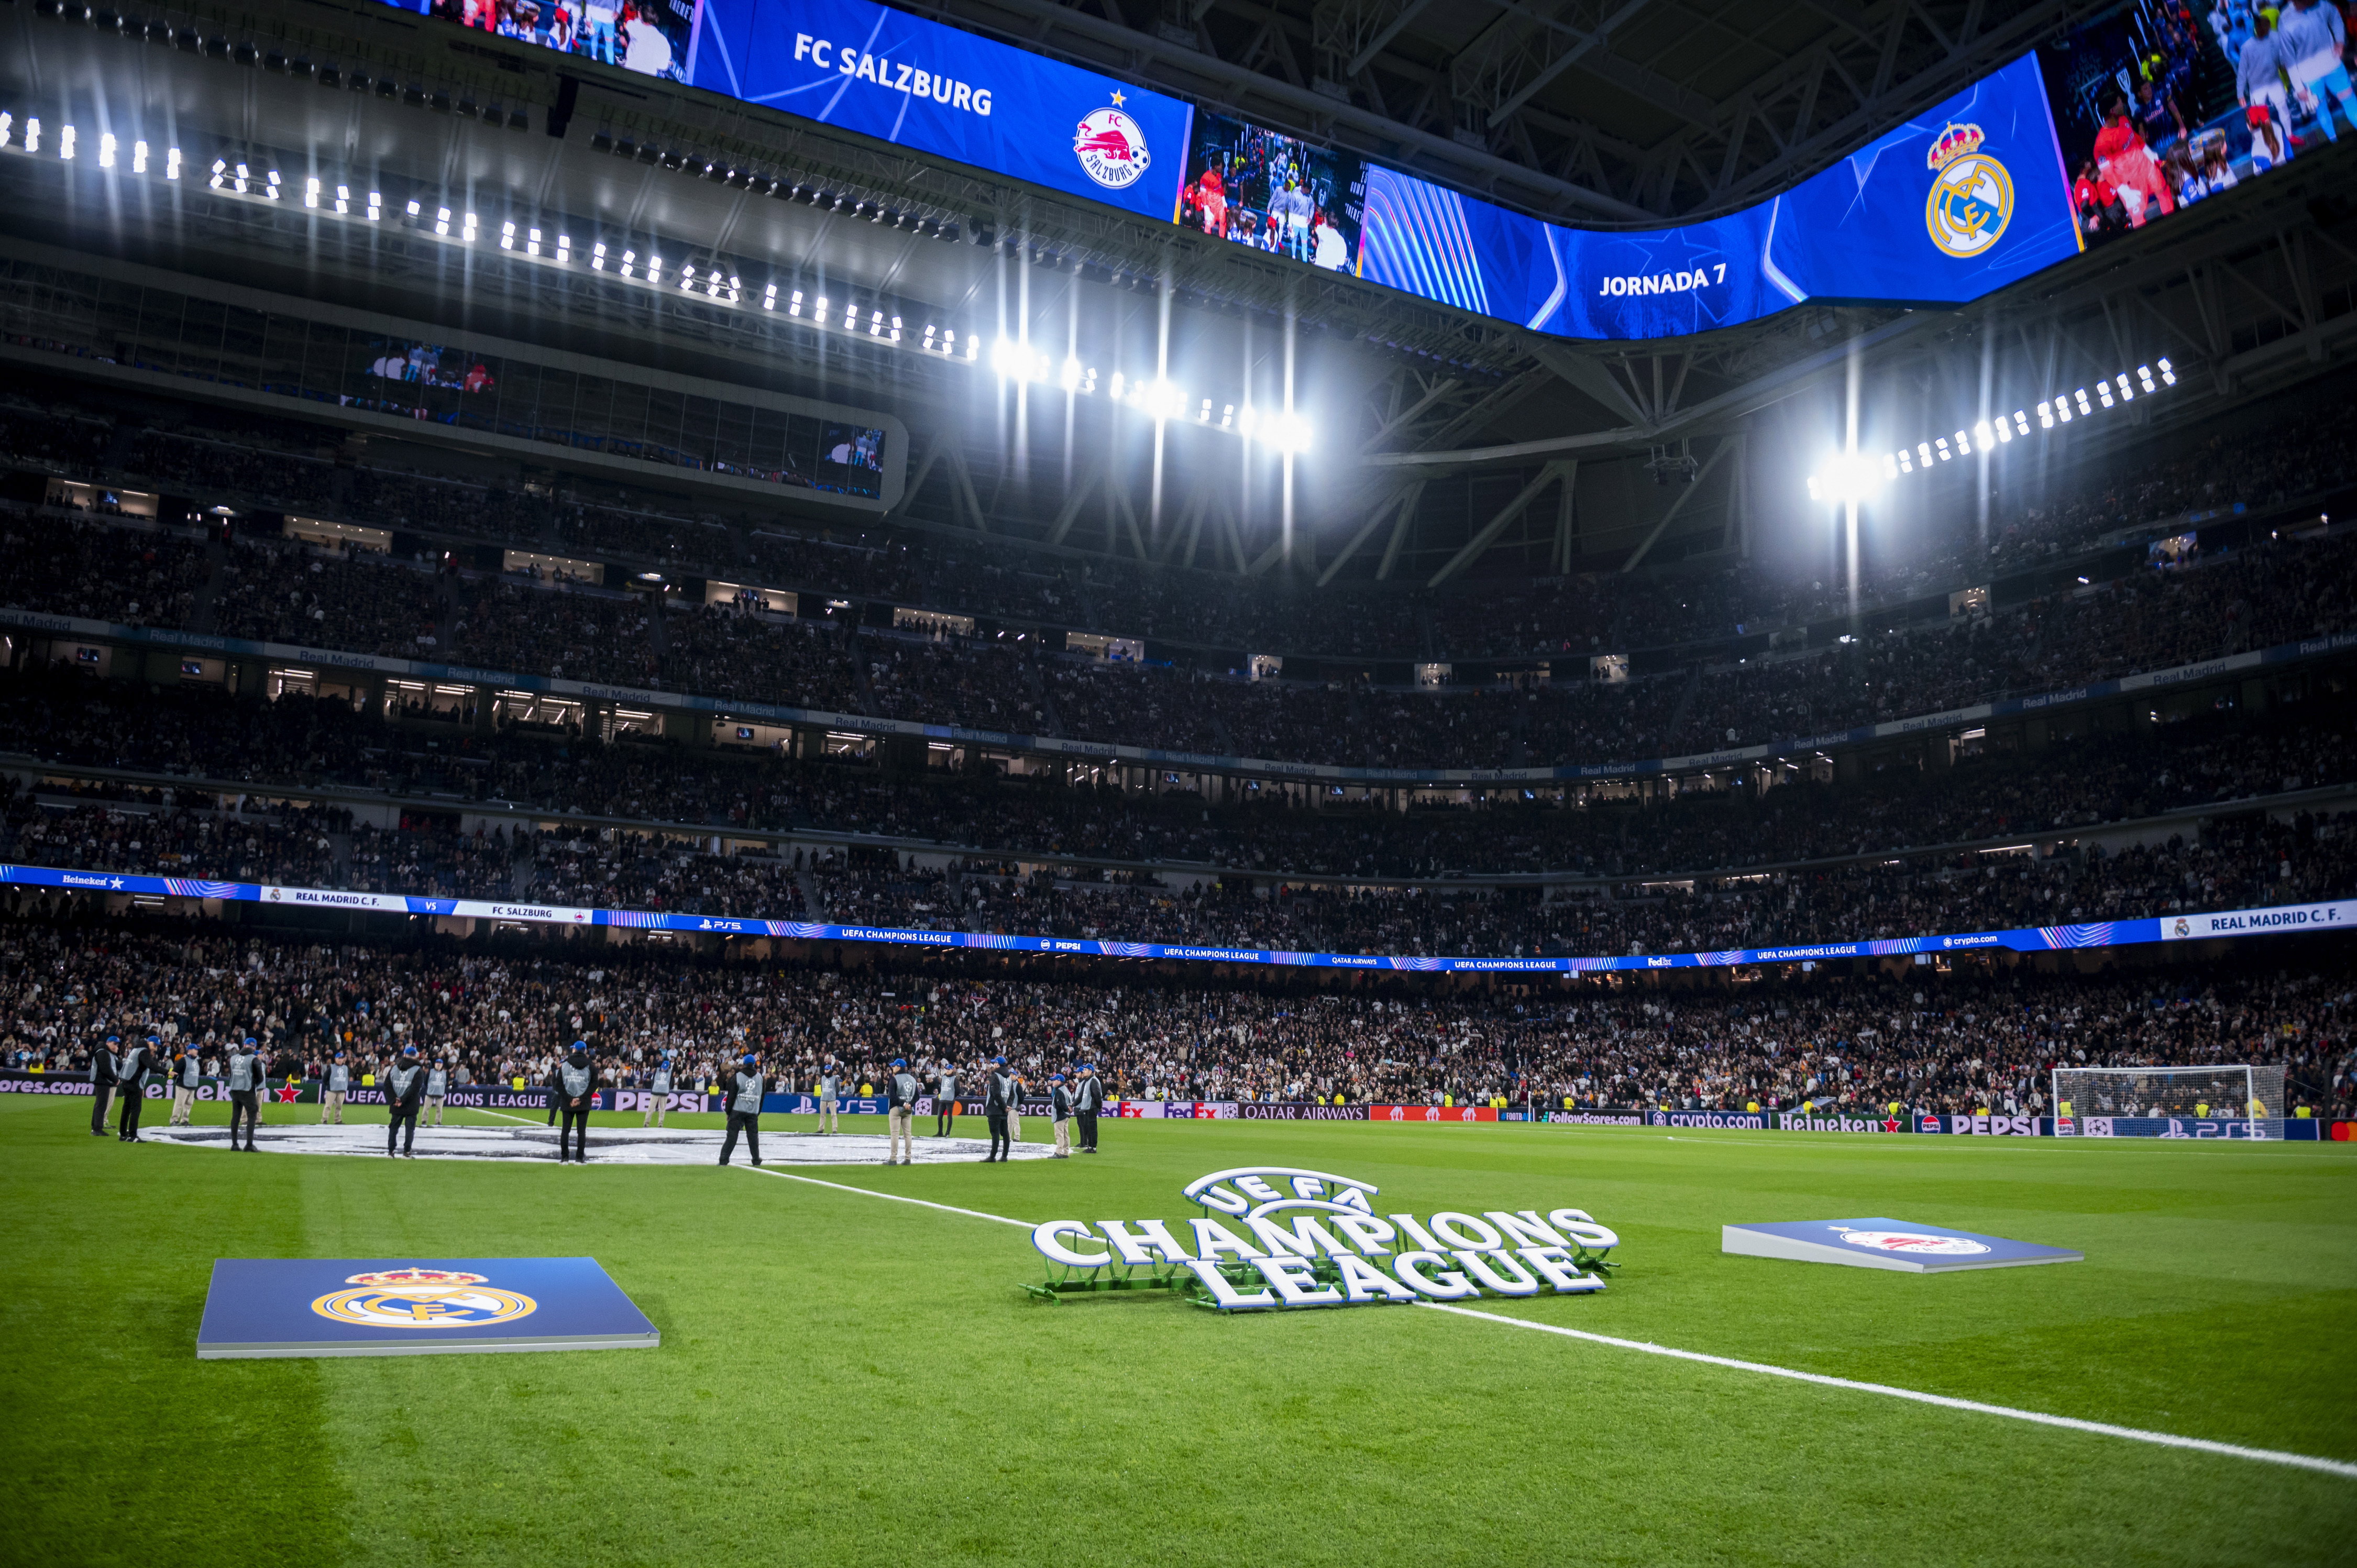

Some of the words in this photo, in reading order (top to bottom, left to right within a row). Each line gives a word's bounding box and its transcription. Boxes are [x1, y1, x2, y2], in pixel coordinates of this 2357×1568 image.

[794, 32, 832, 69] FC
[839, 47, 992, 116] SALZBURG
[1109, 113, 1122, 127] FC
[1086, 154, 1132, 181] SALZBURG
[1600, 268, 1709, 296] JORNADA
[1713, 263, 1727, 284] 7
[23, 615, 71, 630] Madrid
[150, 631, 178, 642] Real
[181, 632, 225, 648] Madrid
[2299, 638, 2328, 654] Real
[300, 650, 328, 662] Real
[332, 654, 375, 669] Madrid
[447, 668, 473, 678] Real
[476, 670, 515, 684] Madrid
[2154, 673, 2180, 686] Real
[2184, 662, 2226, 679] Madrid
[583, 686, 610, 697] Real
[612, 688, 650, 701] Madrid
[2023, 698, 2046, 709] Real
[2049, 689, 2087, 704] Madrid
[714, 701, 739, 711] Real
[741, 703, 775, 715] Madrid
[835, 717, 858, 727] Real
[861, 719, 896, 731] Madrid
[1903, 721, 1924, 732] Real
[1928, 713, 1962, 727] Madrid
[976, 731, 1008, 743] Madrid
[1794, 739, 1813, 749] Real
[1816, 733, 1847, 746] Madrid
[1062, 743, 1084, 753] Real
[1086, 745, 1116, 755] Madrid
[1166, 754, 1184, 763] Real
[1186, 756, 1215, 765] Madrid
[1689, 757, 1707, 767] Real
[1710, 753, 1742, 765] Madrid
[1265, 764, 1284, 772] Real
[1286, 765, 1315, 776] Madrid
[1581, 767, 1601, 776] Real
[1604, 764, 1635, 774] Madrid
[63, 875, 106, 886] Heineken
[296, 892, 320, 902] REAL
[322, 893, 359, 904] MADRID
[361, 896, 370, 905] C.
[372, 897, 379, 906] F.
[426, 902, 437, 910] VS
[492, 907, 503, 915] FC
[507, 908, 552, 918] SALZBURG
[2211, 917, 2246, 931] REAL
[2249, 911, 2307, 927] MADRID
[2310, 910, 2325, 922] C.
[2328, 908, 2341, 920] F.
[842, 930, 864, 939] UEFA
[866, 931, 917, 942] CHAMPIONS
[919, 934, 952, 944] LEAGUE
[1954, 935, 1998, 946] crypto.com
[1056, 942, 1081, 950] PEPSI
[1757, 951, 1777, 959] UEFA
[1778, 947, 1824, 958] CHAMPIONS
[1826, 945, 1857, 955] LEAGUE
[1164, 948, 1184, 956] UEFA
[1185, 949, 1229, 958] CHAMPIONS
[1231, 951, 1259, 960] LEAGUE
[1648, 957, 1672, 966] FedEx
[346, 1090, 386, 1103] UEFA
[490, 1094, 547, 1108] LEAGUE
[1098, 1101, 1144, 1118] edEx
[1164, 1103, 1217, 1119] FedEx
[1246, 1106, 1295, 1120] QATAR
[1302, 1107, 1363, 1120] AIRWAYS
[1549, 1111, 1640, 1122] FollowScores.com
[1670, 1112, 1762, 1129] crypto.com
[1779, 1113, 1879, 1131] Heineken
[1952, 1116, 2041, 1136] PEPSI
[1198, 1175, 1374, 1216] UEFA
[1031, 1208, 1620, 1266] CHAMPIONS
[1185, 1246, 1607, 1308] LEAGUE
